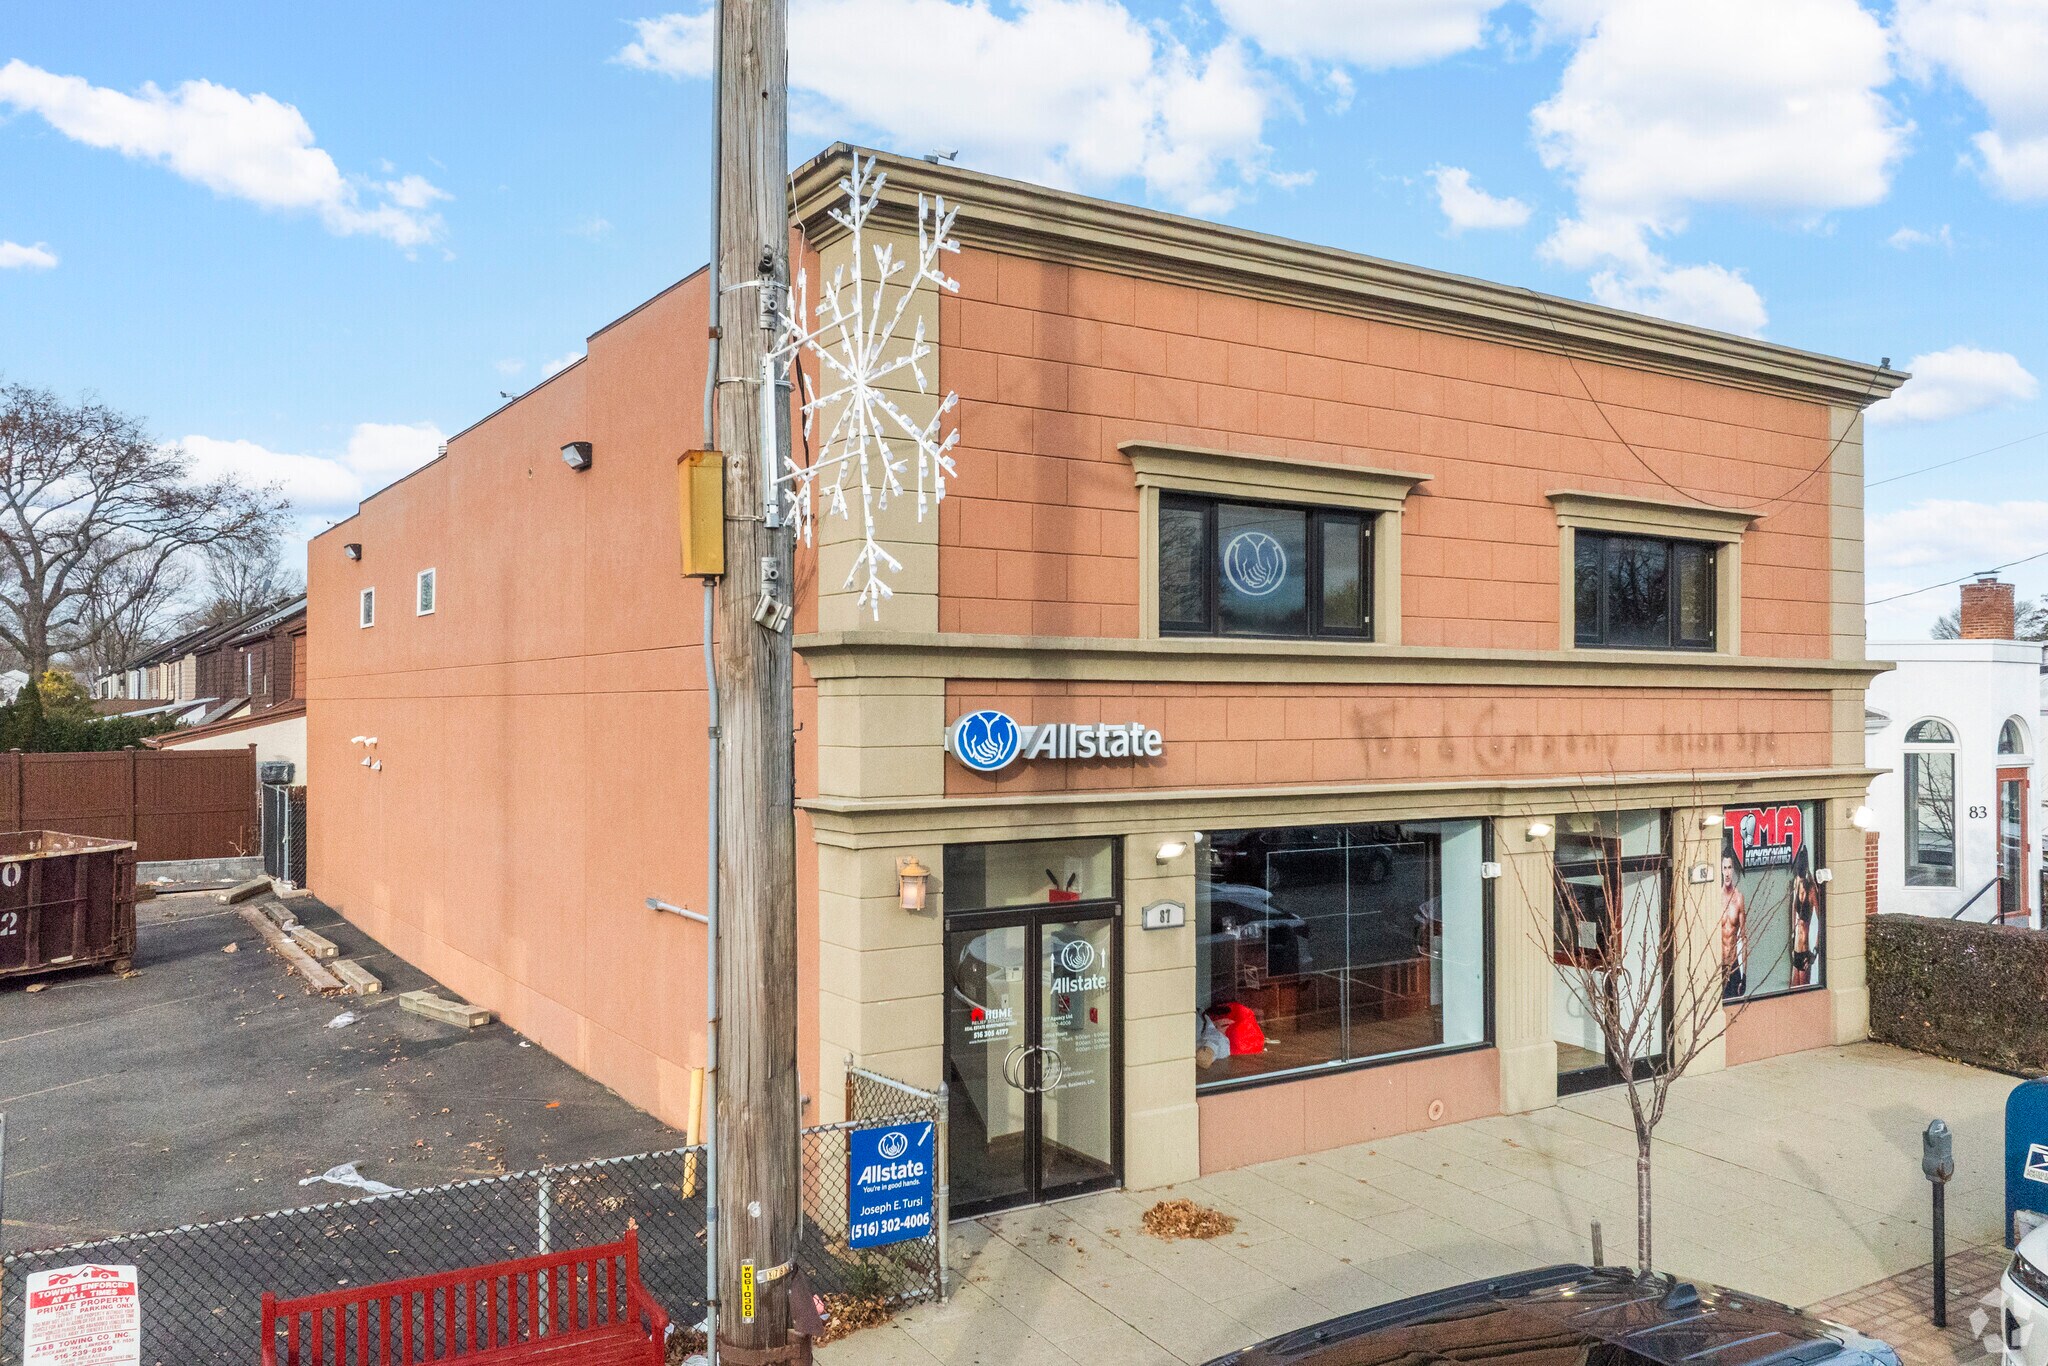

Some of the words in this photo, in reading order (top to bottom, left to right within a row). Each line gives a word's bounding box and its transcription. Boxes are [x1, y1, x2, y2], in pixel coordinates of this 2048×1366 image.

[1023, 721, 1163, 760] Allstate
[1969, 806, 1987, 819] 83
[1724, 806, 1803, 868] TMA
[1159, 909, 1171, 923] 87
[1050, 973, 1107, 995] Allstate
[985, 1007, 1012, 1020] HOME
[857, 1160, 924, 1186] Allstate
[863, 1184, 881, 1194] You're
[881, 1183, 887, 1191] in
[888, 1181, 902, 1192] good
[903, 1178, 921, 1188] hands.
[860, 1201, 892, 1217] Joseph
[893, 1201, 901, 1210] E.
[903, 1196, 923, 1209] Tursi
[851, 1221, 879, 1240] (516)
[880, 1212, 930, 1233] 302-4006
[38, 1285, 77, 1299] TOWING
[81, 1281, 129, 1292] ENFORCED
[51, 1296, 63, 1304] AT
[68, 1292, 87, 1301] ALL
[91, 1289, 118, 1297] TIMES
[37, 1302, 77, 1315] PRIVATE
[80, 1297, 131, 1308] PROPERTY
[79, 1304, 114, 1313] PARKING
[35, 1343, 54, 1353] A&B
[59, 1336, 93, 1348] TOWING
